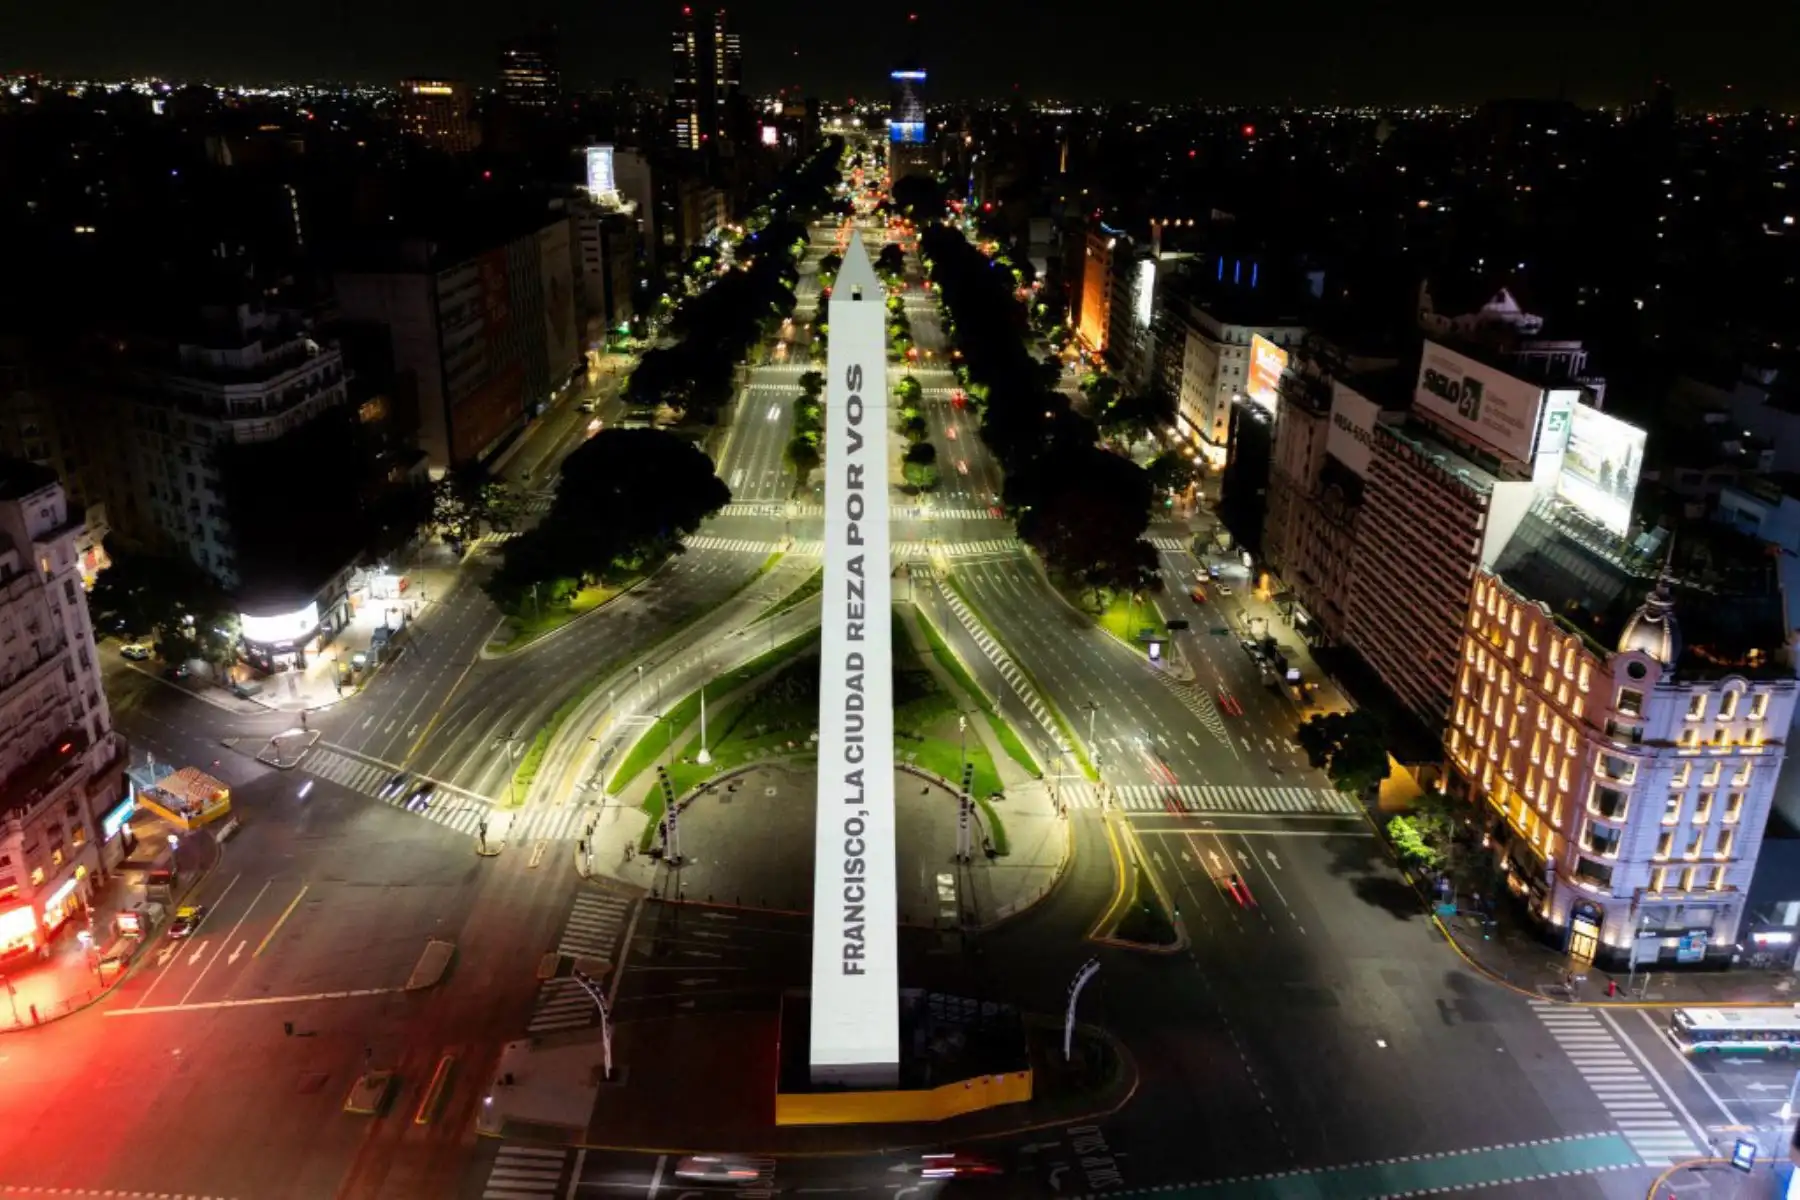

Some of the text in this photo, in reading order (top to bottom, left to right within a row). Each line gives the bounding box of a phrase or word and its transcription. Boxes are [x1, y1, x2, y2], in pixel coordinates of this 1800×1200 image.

[843, 364, 869, 976] FRANCISCO, LA CIUDAD REZA POR VOS
